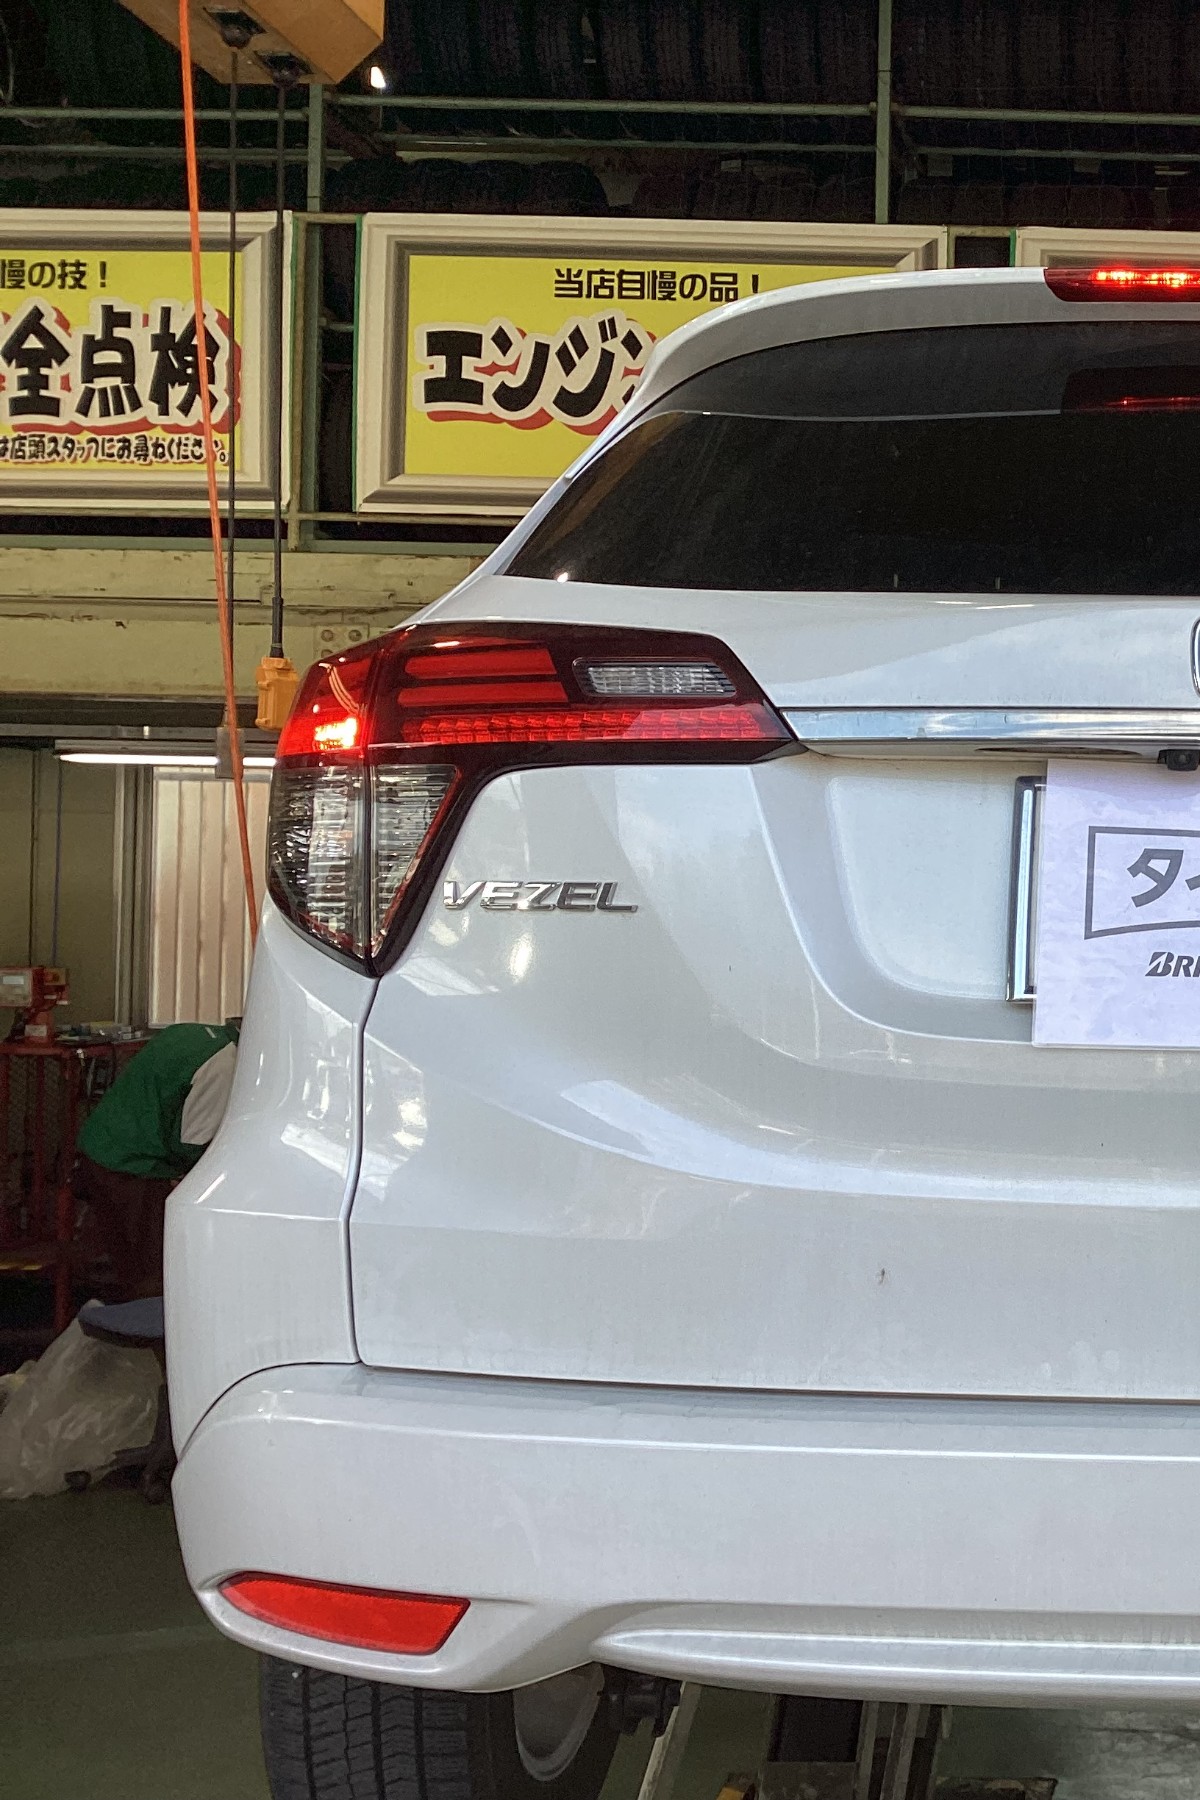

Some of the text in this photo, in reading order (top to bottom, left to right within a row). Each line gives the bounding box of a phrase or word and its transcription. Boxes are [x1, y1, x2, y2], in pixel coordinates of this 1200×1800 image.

[0, 304, 220, 418] 全点検
[443, 880, 638, 913] VEZEL
